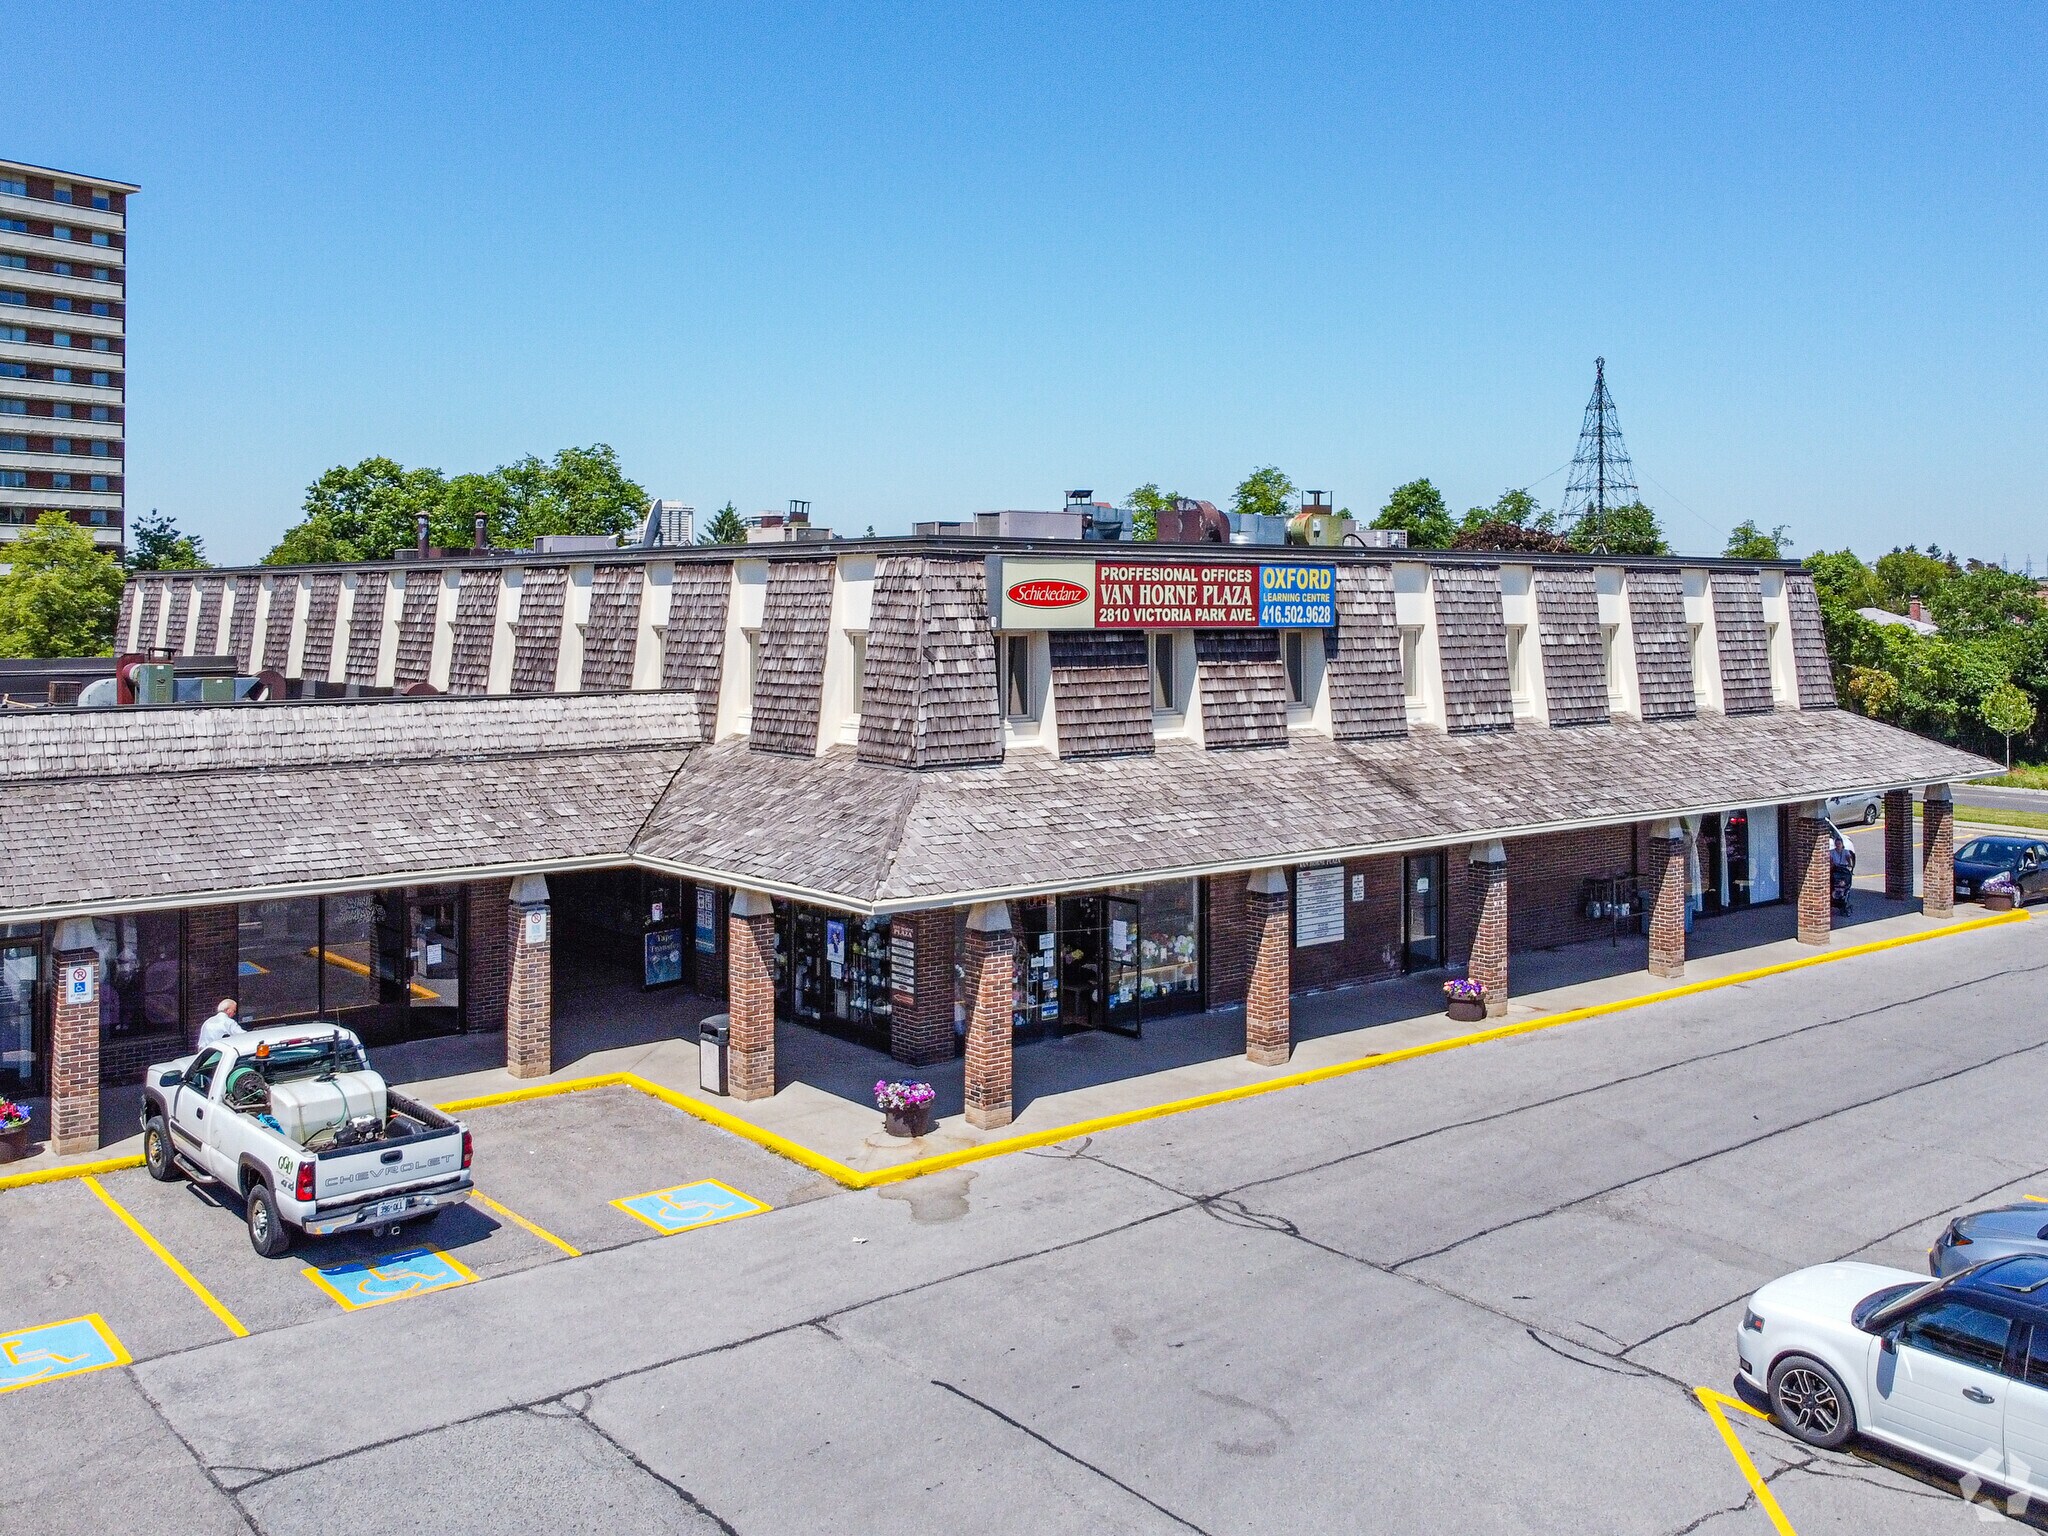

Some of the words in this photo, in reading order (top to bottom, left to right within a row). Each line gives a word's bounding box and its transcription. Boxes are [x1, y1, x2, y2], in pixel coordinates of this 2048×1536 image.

[1101, 567, 1198, 582] PROFFESIONAL
[1202, 569, 1252, 582] OFFICES
[1263, 568, 1331, 589] OXFORD
[1017, 585, 1081, 602] Schickedanz
[1100, 584, 1134, 606] VAN
[1139, 585, 1199, 606] HORNE
[1203, 585, 1252, 606] PLAZA
[1263, 593, 1300, 603] LEARNING
[1302, 593, 1330, 603] CENTRE
[1099, 607, 1129, 622] 2810
[1133, 608, 1192, 622] VICTORIA
[1195, 608, 1227, 622] PARK
[1229, 608, 1256, 622] AVE.
[1262, 605, 1331, 624] 416.502.9628
[325, 1154, 455, 1187] CHEVROLET
